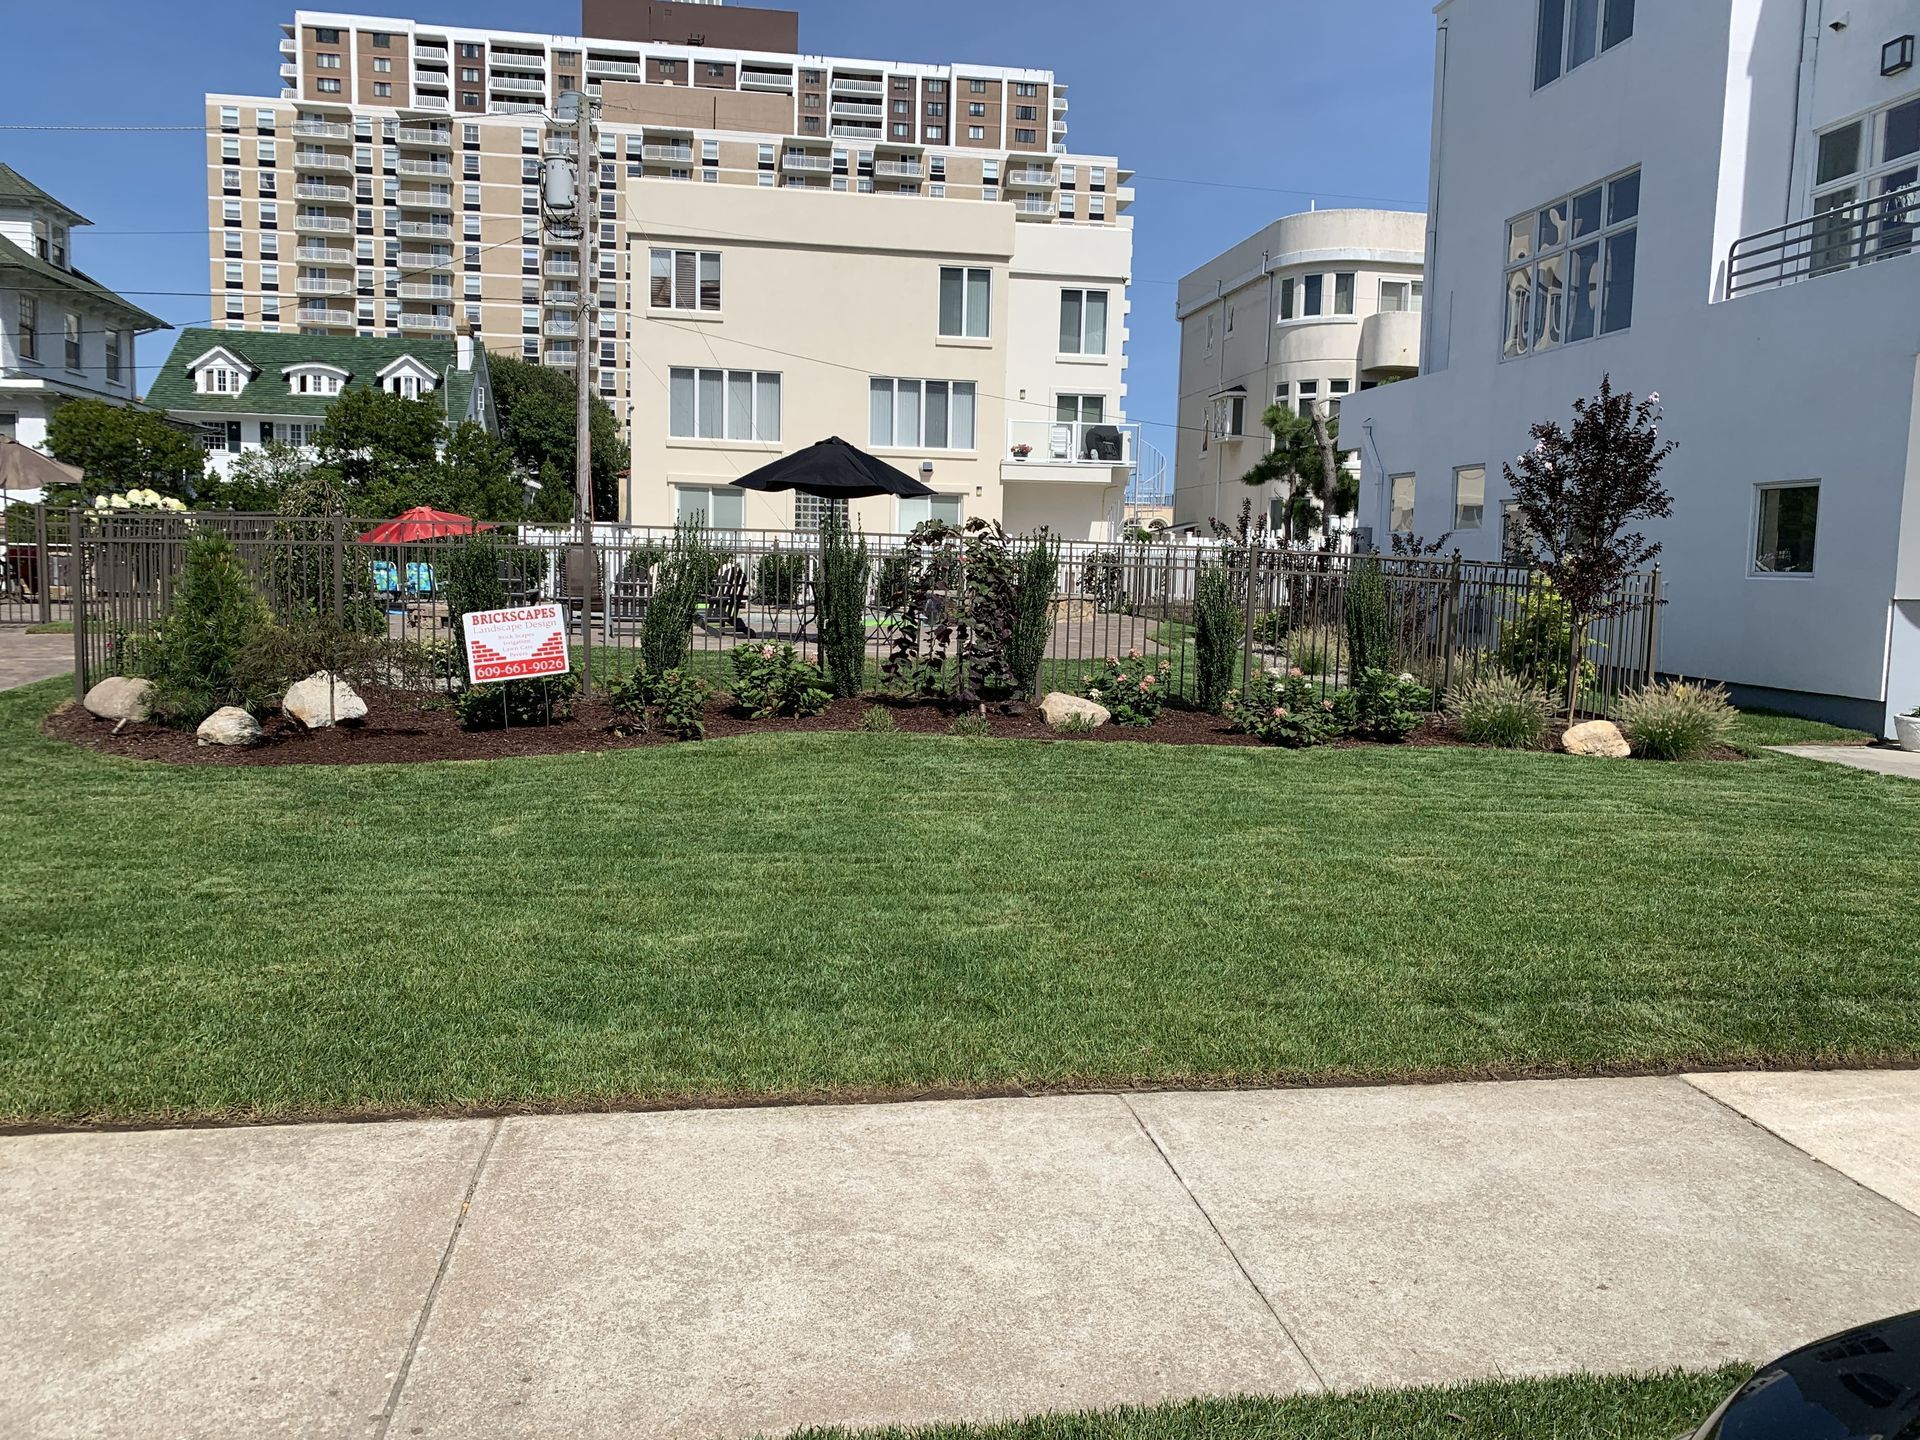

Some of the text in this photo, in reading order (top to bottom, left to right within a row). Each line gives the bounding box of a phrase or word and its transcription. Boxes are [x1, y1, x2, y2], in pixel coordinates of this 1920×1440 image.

[472, 607, 556, 626] BRICKSCAPES
[473, 620, 557, 634] Landscape Design
[476, 658, 564, 678] 609-661-9026
